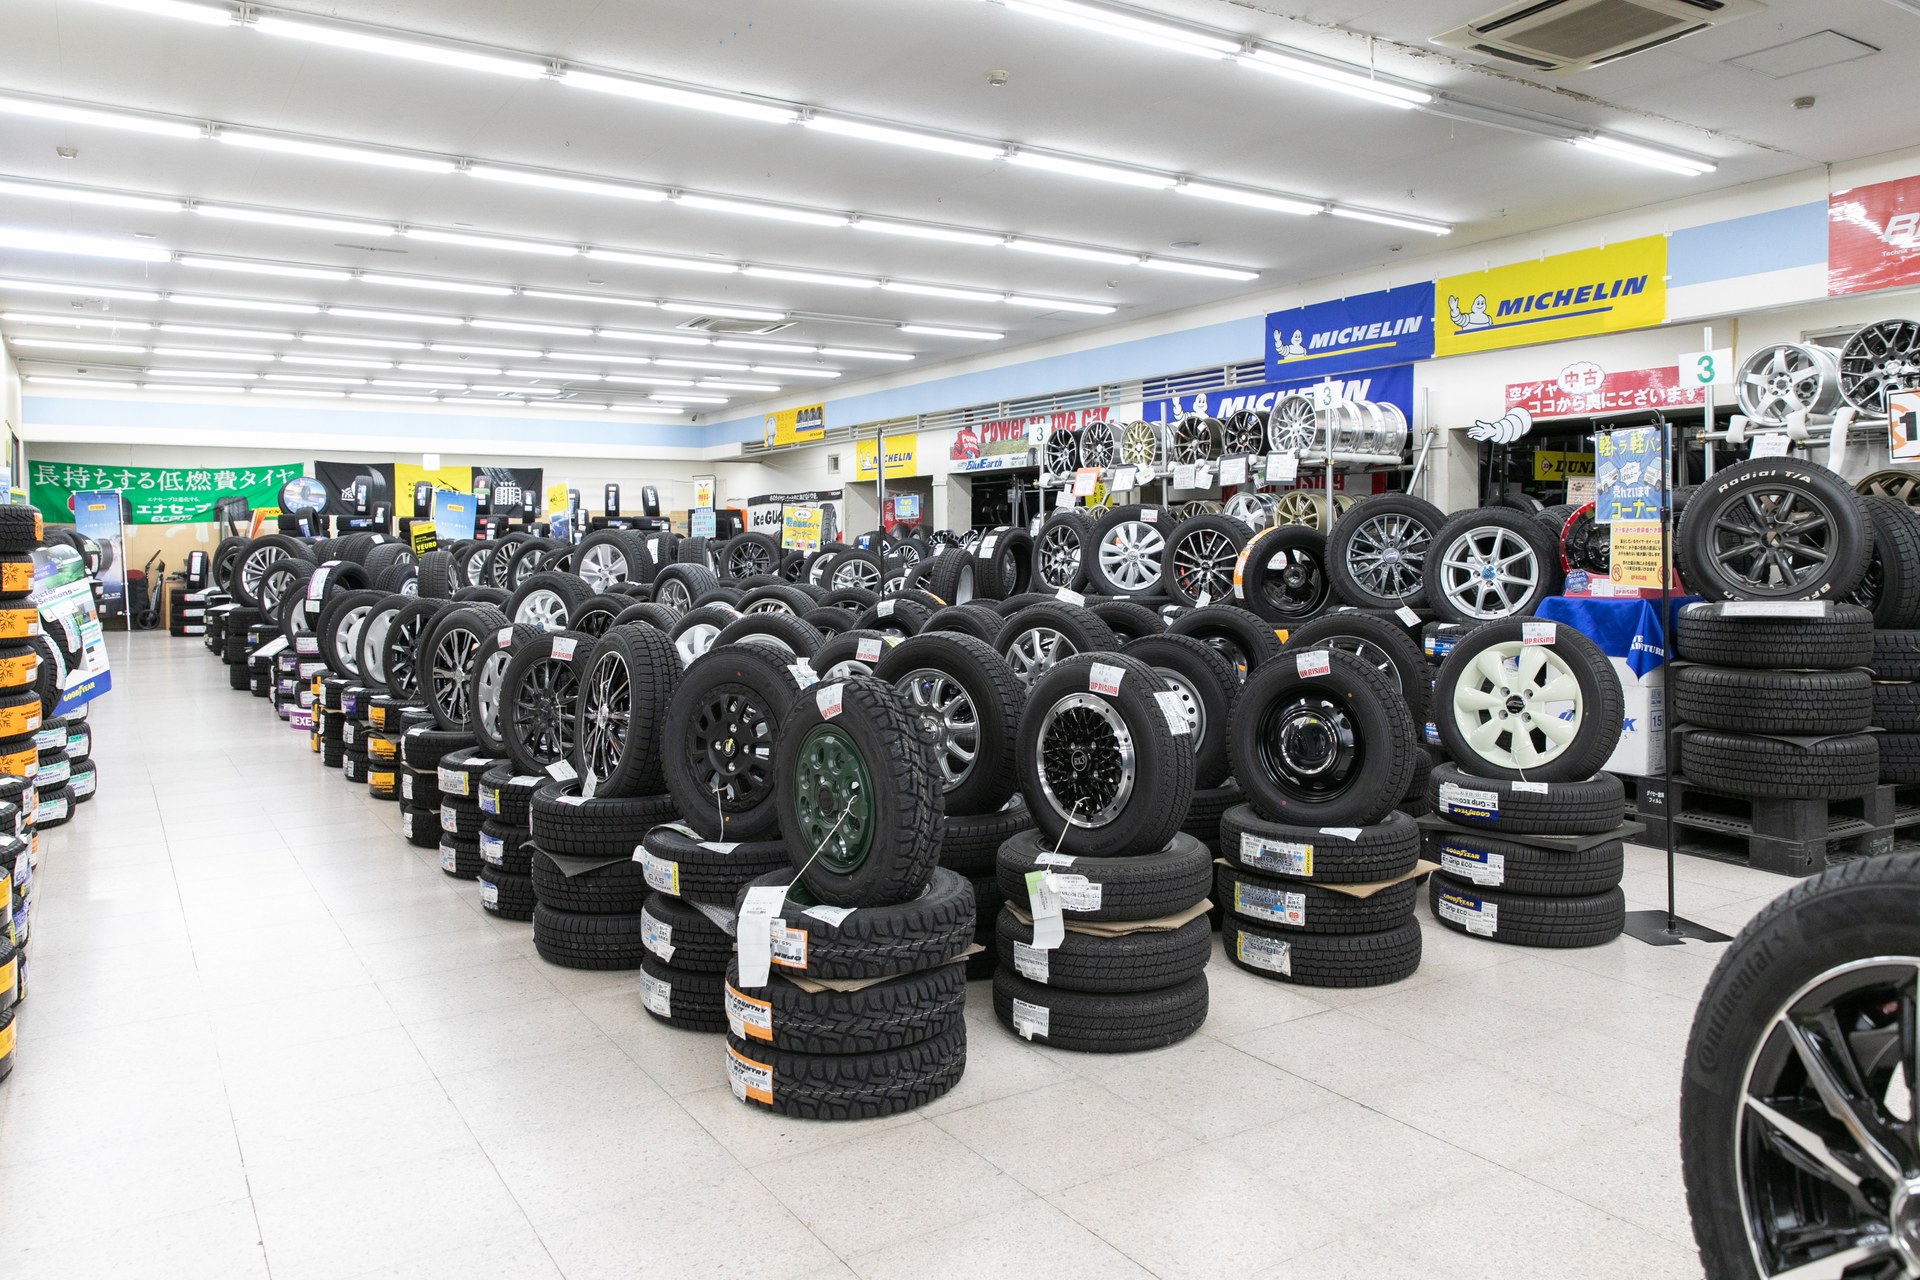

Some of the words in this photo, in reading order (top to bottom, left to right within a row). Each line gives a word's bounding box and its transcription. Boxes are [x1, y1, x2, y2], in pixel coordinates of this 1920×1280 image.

[1496, 274, 1648, 317] MICHELIN
[1308, 315, 1423, 350] MICHELIN
[1565, 368, 1598, 388] 中古
[1697, 355, 1716, 384] 3
[1323, 386, 1333, 406] 3
[1509, 383, 1559, 402] 空タイヤ
[1528, 385, 1697, 414] ココから奥にございます
[1036, 427, 1044, 441] 3
[1598, 435, 1627, 457] 軽トラ
[966, 457, 1003, 471] BluEarth
[33, 463, 296, 493] 長持ちする低燃費タイヤ
[1718, 469, 1777, 494] Radial
[1784, 469, 1812, 484] T/A
[1613, 486, 1651, 499] 売れています
[136, 503, 212, 515] エナセーブ
[1610, 499, 1658, 519] コーナー
[63, 680, 96, 702] GOODYEAR
[1652, 715, 1662, 728] 15
[1453, 807, 1491, 818] GOODYEAR
[773, 951, 802, 961] OPEN
[733, 996, 767, 1014] COUNTRY
[734, 1058, 768, 1077] COUNTRY
